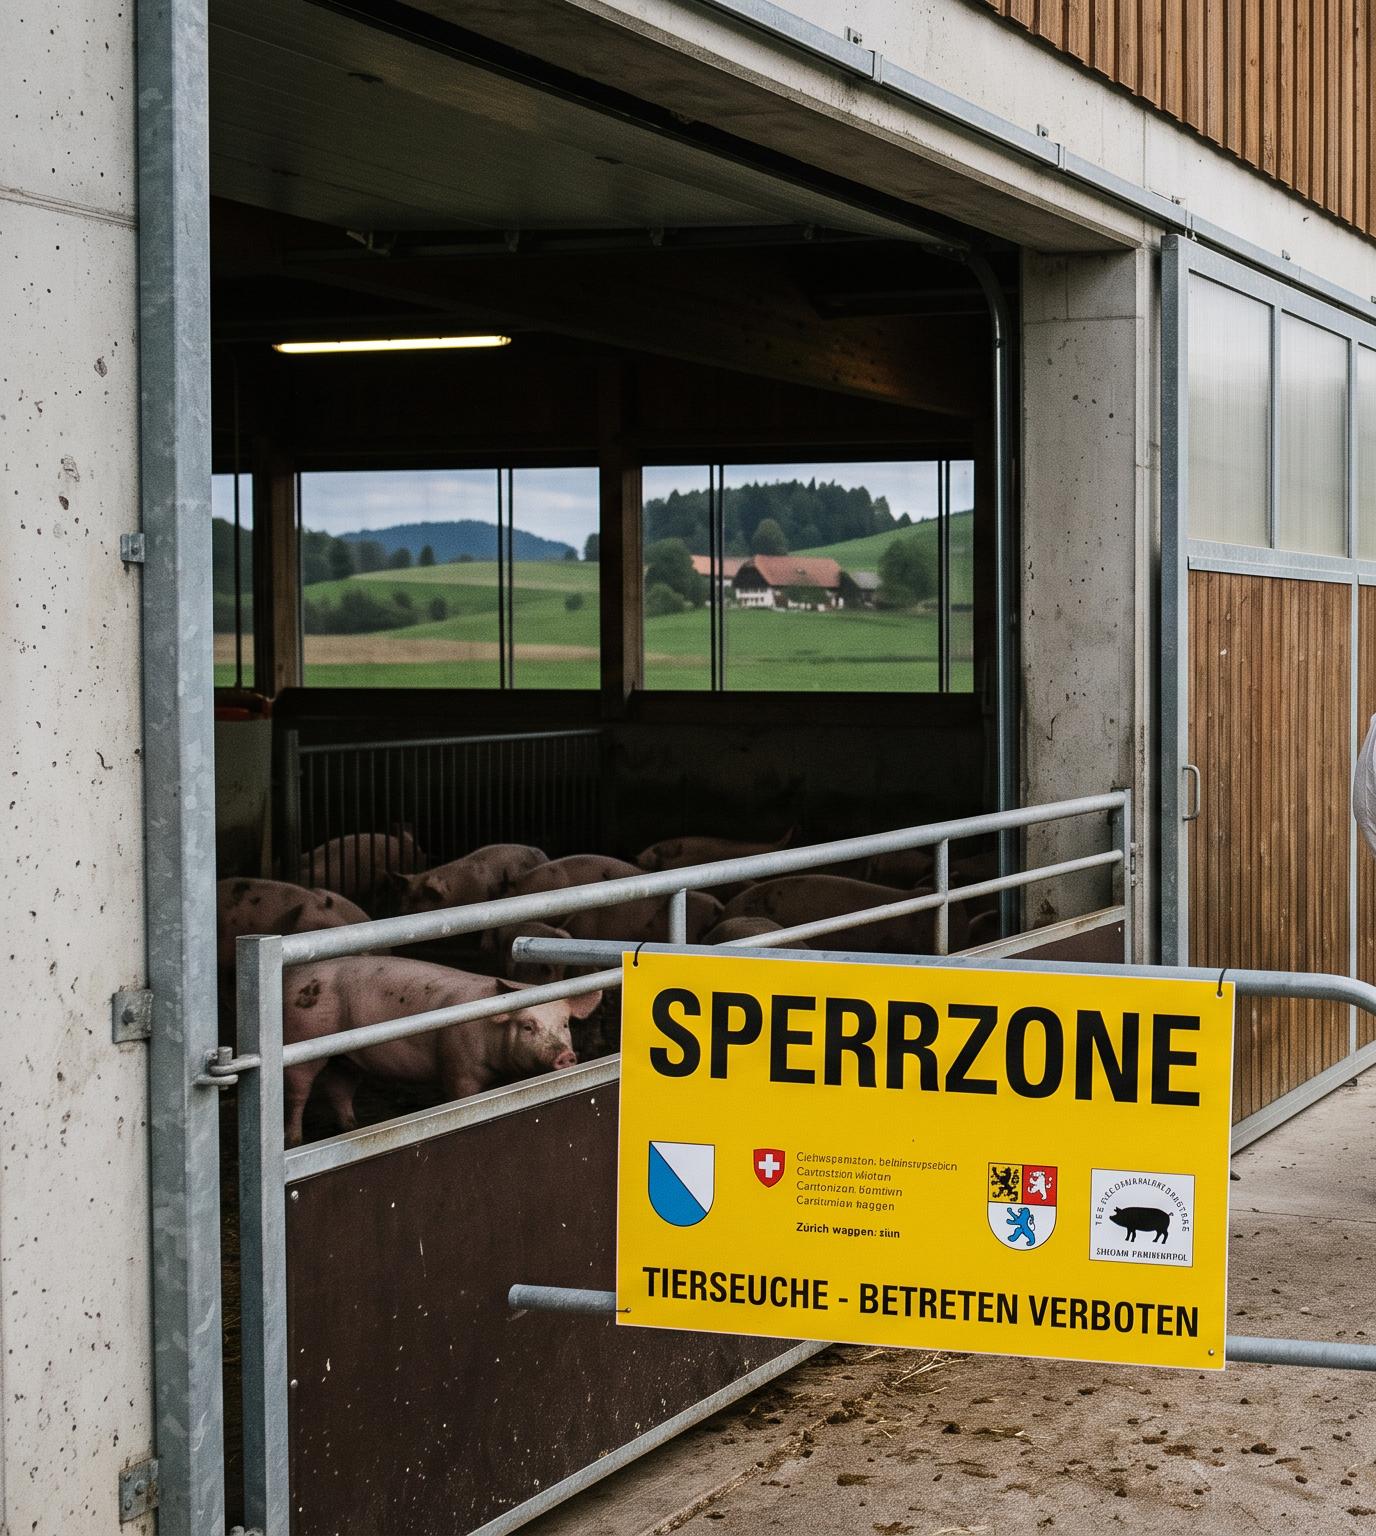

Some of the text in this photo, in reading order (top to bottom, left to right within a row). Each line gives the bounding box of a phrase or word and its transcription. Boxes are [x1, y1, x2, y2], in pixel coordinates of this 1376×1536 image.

[649, 987, 1201, 1107] SPERRZONE
[642, 1266, 829, 1310] TIERSEUCHE
[859, 1283, 1018, 1325] BETRETEN
[1028, 1295, 1198, 1338] VERBOTEN
